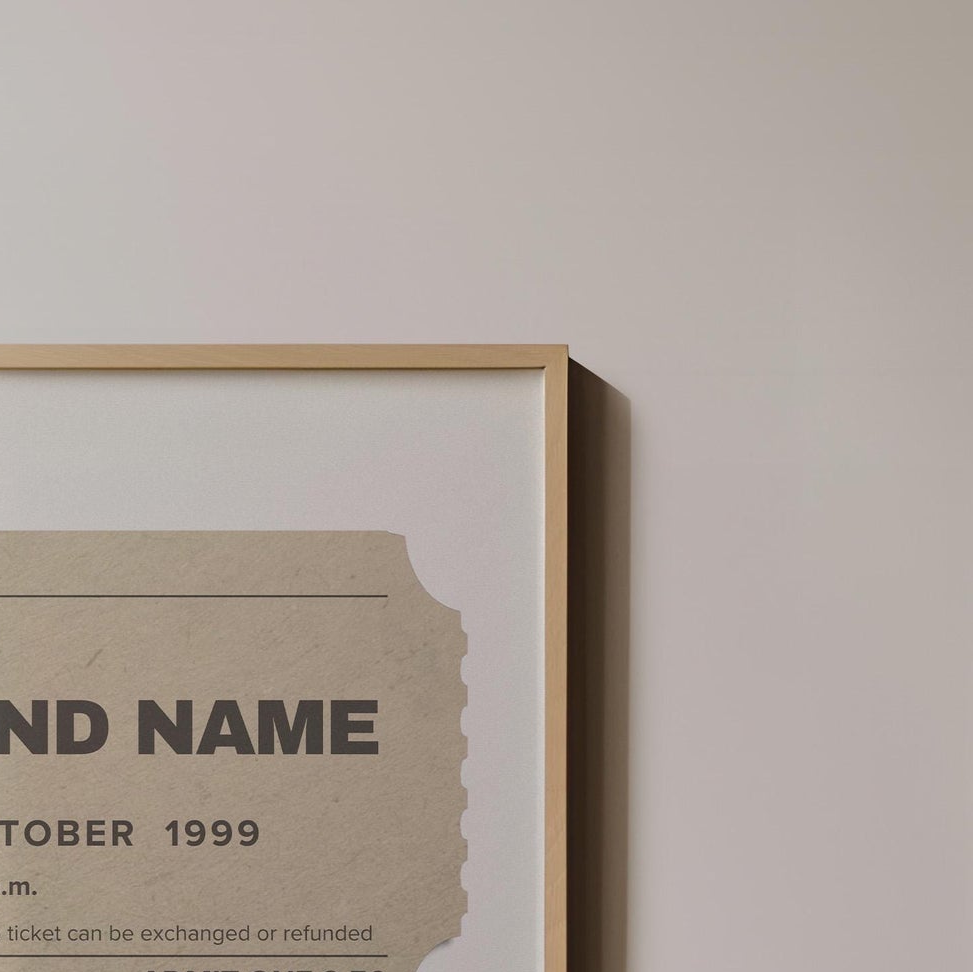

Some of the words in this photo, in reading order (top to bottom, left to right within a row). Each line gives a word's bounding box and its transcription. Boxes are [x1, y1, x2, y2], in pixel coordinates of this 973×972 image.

[137, 699, 379, 755] NAME
[164, 819, 260, 847] 1999
[6, 924, 62, 942] ticket
[67, 928, 102, 942] can
[109, 924, 134, 942] be
[140, 924, 250, 946] exchanged
[257, 928, 278, 942] or
[283, 924, 373, 942] refunded
